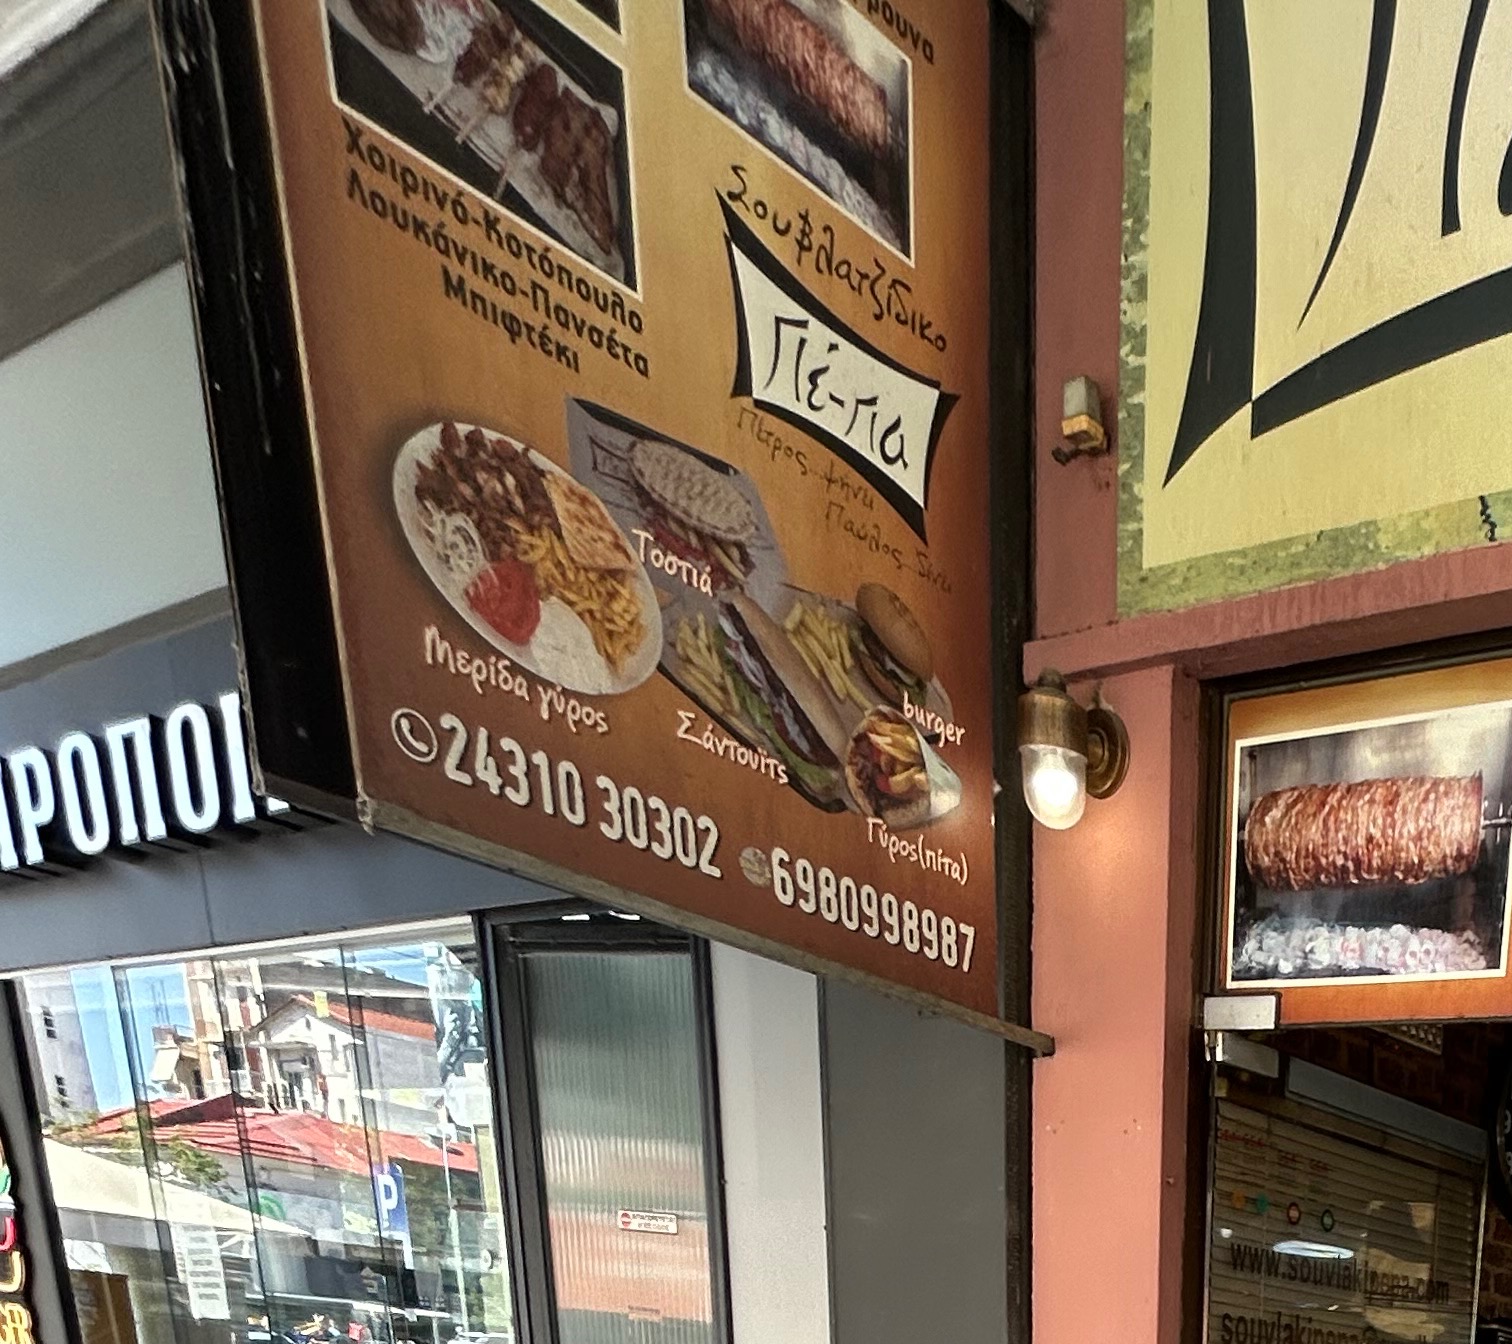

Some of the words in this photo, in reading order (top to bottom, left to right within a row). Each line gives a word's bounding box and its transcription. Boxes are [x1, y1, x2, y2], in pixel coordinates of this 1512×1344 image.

[344, 117, 645, 336] Χοιρινό-Κοτόπουλο
[346, 168, 651, 379] Λουκάνικο-Πανσέτα
[441, 267, 582, 375] Μπιφτέκι
[632, 530, 714, 597] Τοστιά
[423, 626, 530, 703] Μερίδα
[537, 680, 609, 735] γύρος
[903, 693, 966, 748] burger
[438, 713, 586, 828] 24310
[597, 775, 722, 880] 30302
[866, 817, 969, 886] Γύρος(πίτα)
[771, 846, 975, 974] 6980998987
[378, 1174, 399, 1228] P
